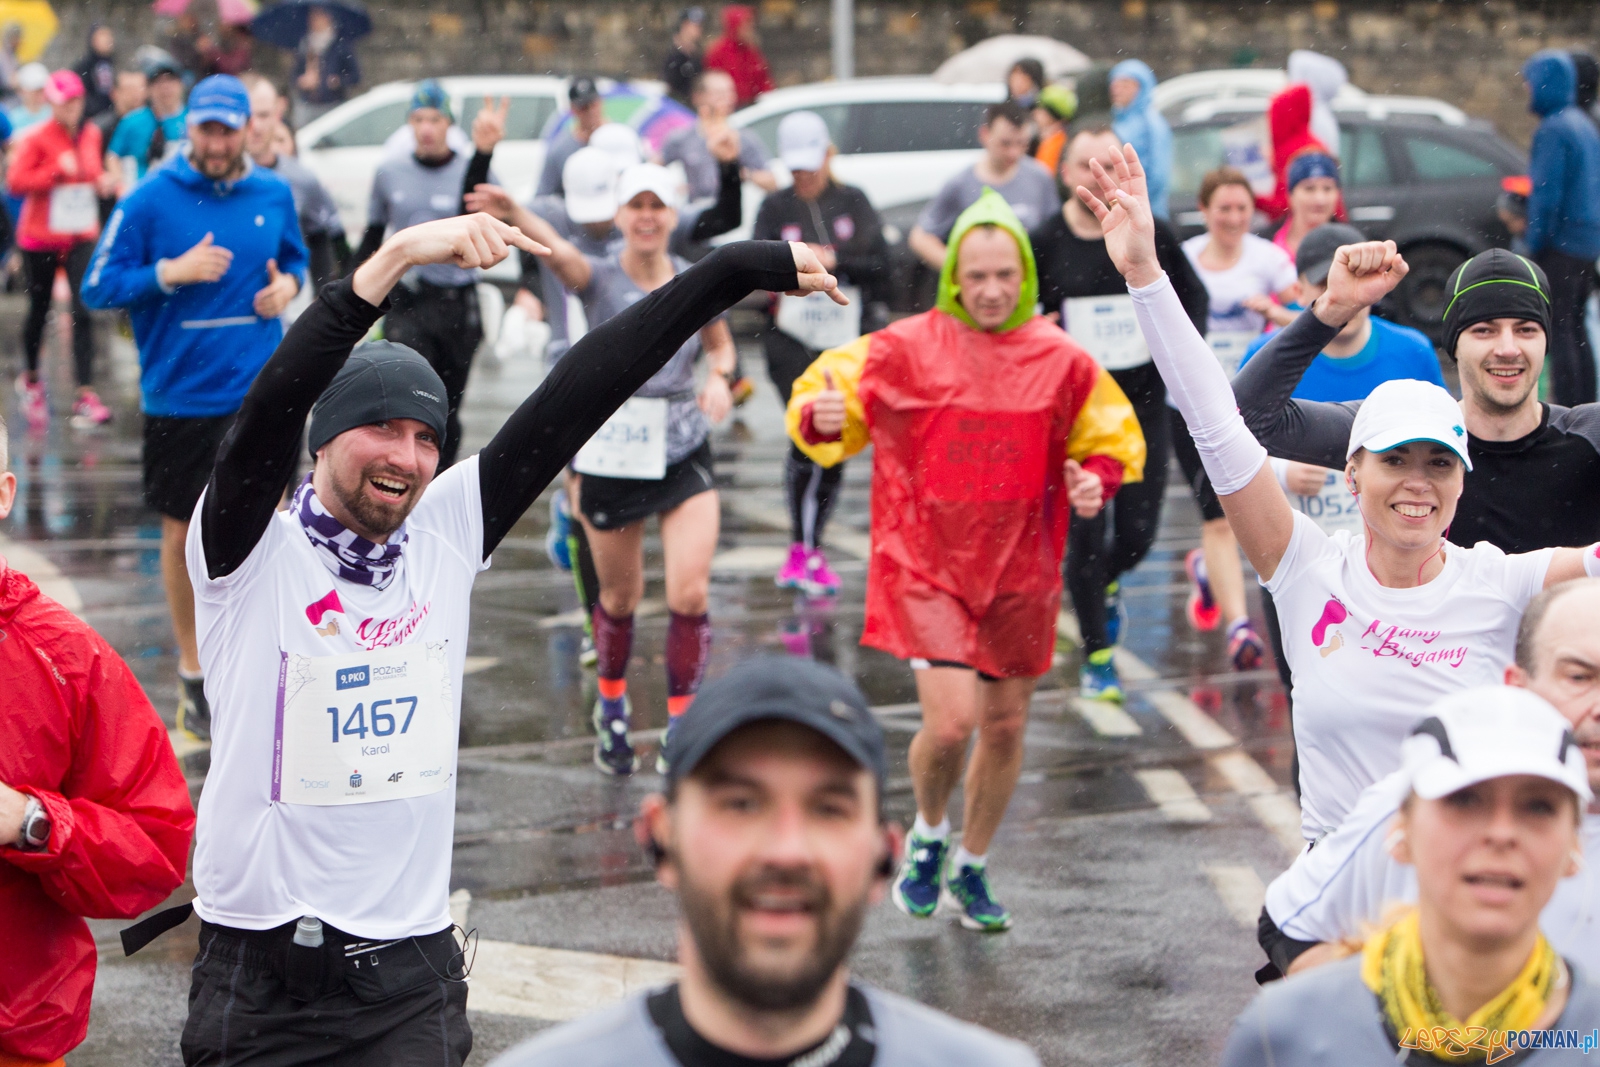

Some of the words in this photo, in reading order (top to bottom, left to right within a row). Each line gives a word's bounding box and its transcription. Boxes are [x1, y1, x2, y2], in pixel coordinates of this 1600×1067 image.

[1361, 619, 1441, 644] Mamy
[327, 695, 418, 742] 1467
[361, 743, 390, 756] Karol
[387, 771, 404, 783] 4F
